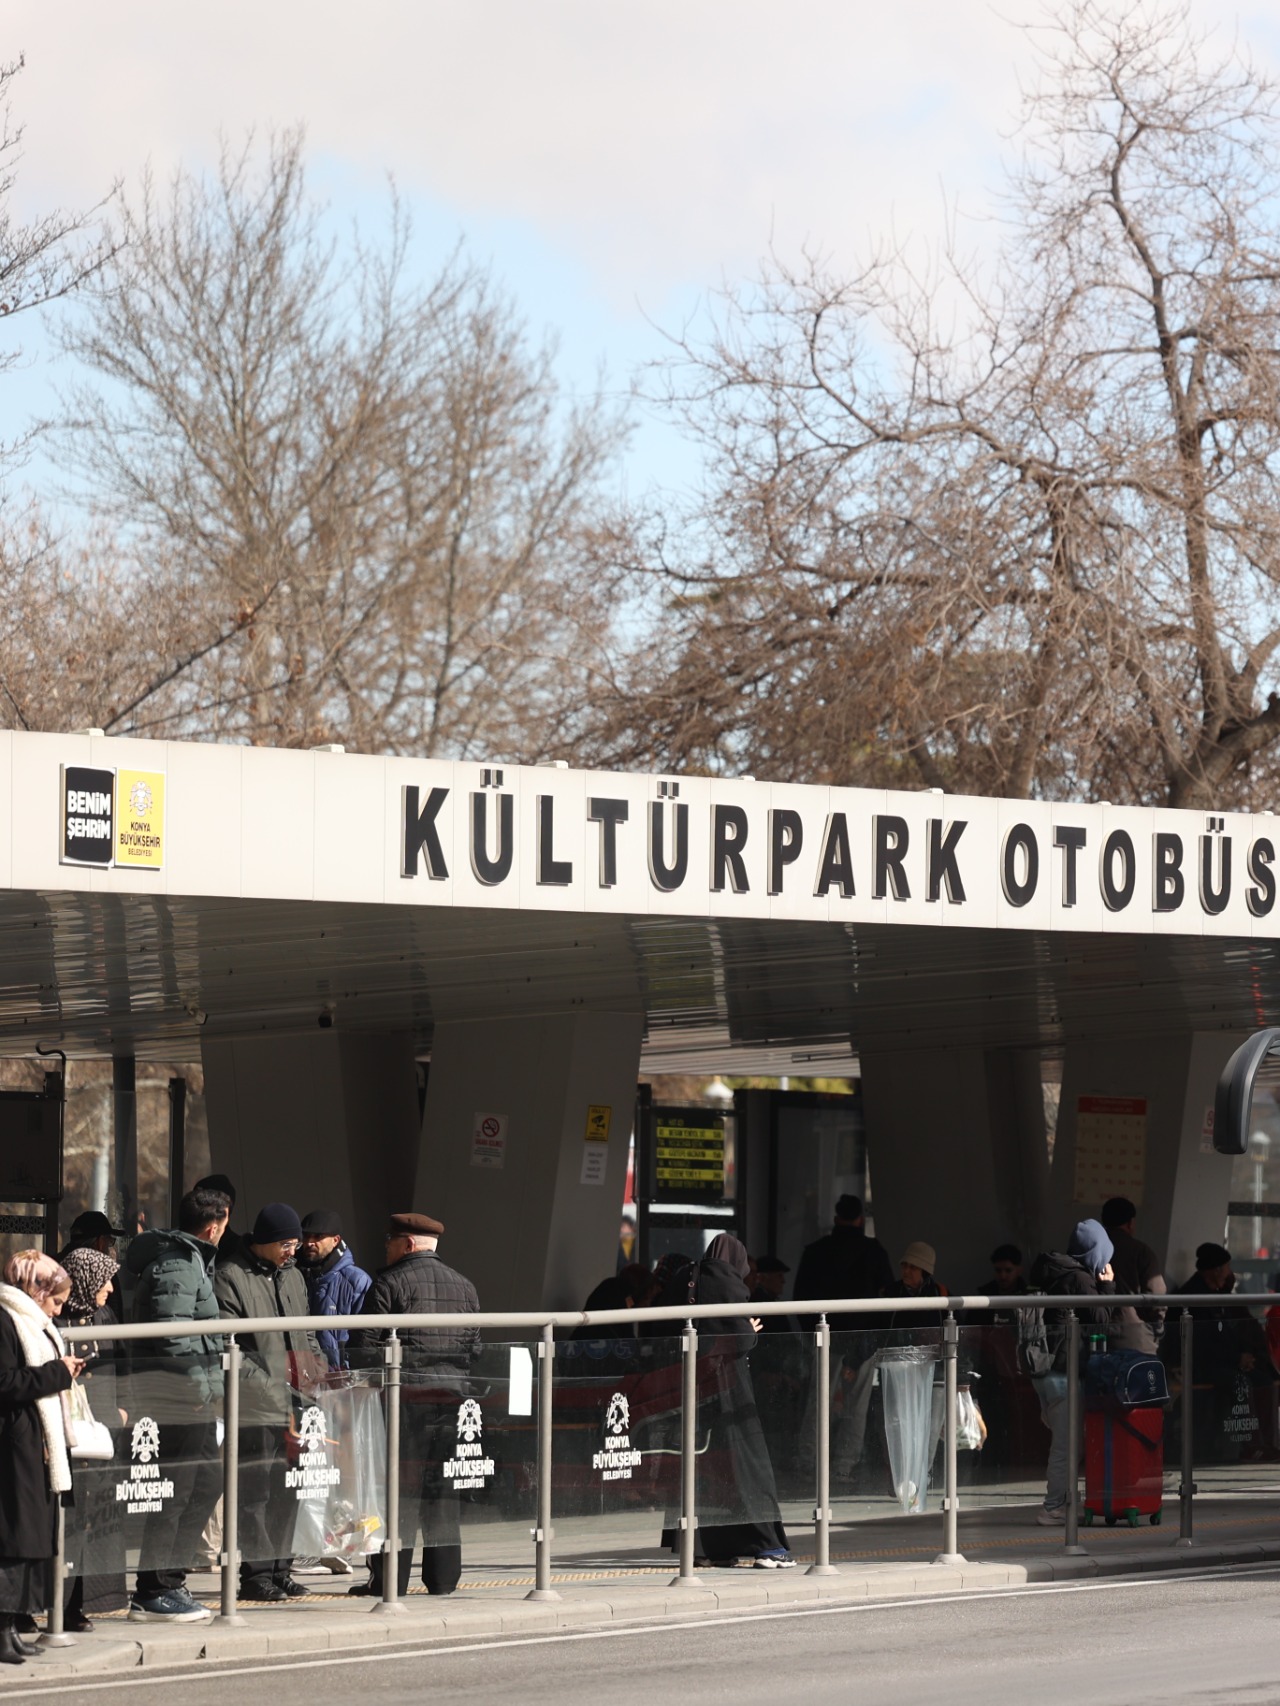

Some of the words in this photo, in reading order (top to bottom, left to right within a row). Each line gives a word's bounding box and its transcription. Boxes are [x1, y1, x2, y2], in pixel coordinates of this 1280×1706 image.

[67, 790, 111, 816] BENİM
[67, 817, 111, 840] ŞEHRİM
[130, 821, 151, 832] KONYA
[120, 831, 161, 848] BÜYÜKŞEHİR
[400, 768, 969, 904] KÜLTÜRPARK
[999, 817, 1276, 918] OTOBÜS
[456, 1443, 483, 1457] KONYA
[605, 1435, 630, 1450] KONYA
[298, 1452, 327, 1466] KONYA
[443, 1456, 495, 1479] BÜYÜKŞEHİR
[592, 1448, 642, 1470] BÜYÜKŞEHİR
[130, 1463, 161, 1480] KONYA
[285, 1465, 341, 1488] BÜYÜKŞEHİR
[115, 1477, 175, 1501] BÜYÜKŞEHİR
[453, 1476, 485, 1490] BELEDİYESİ
[296, 1485, 330, 1500] BELEDİYESİ
[127, 1499, 163, 1514] BELEDİYESİ
